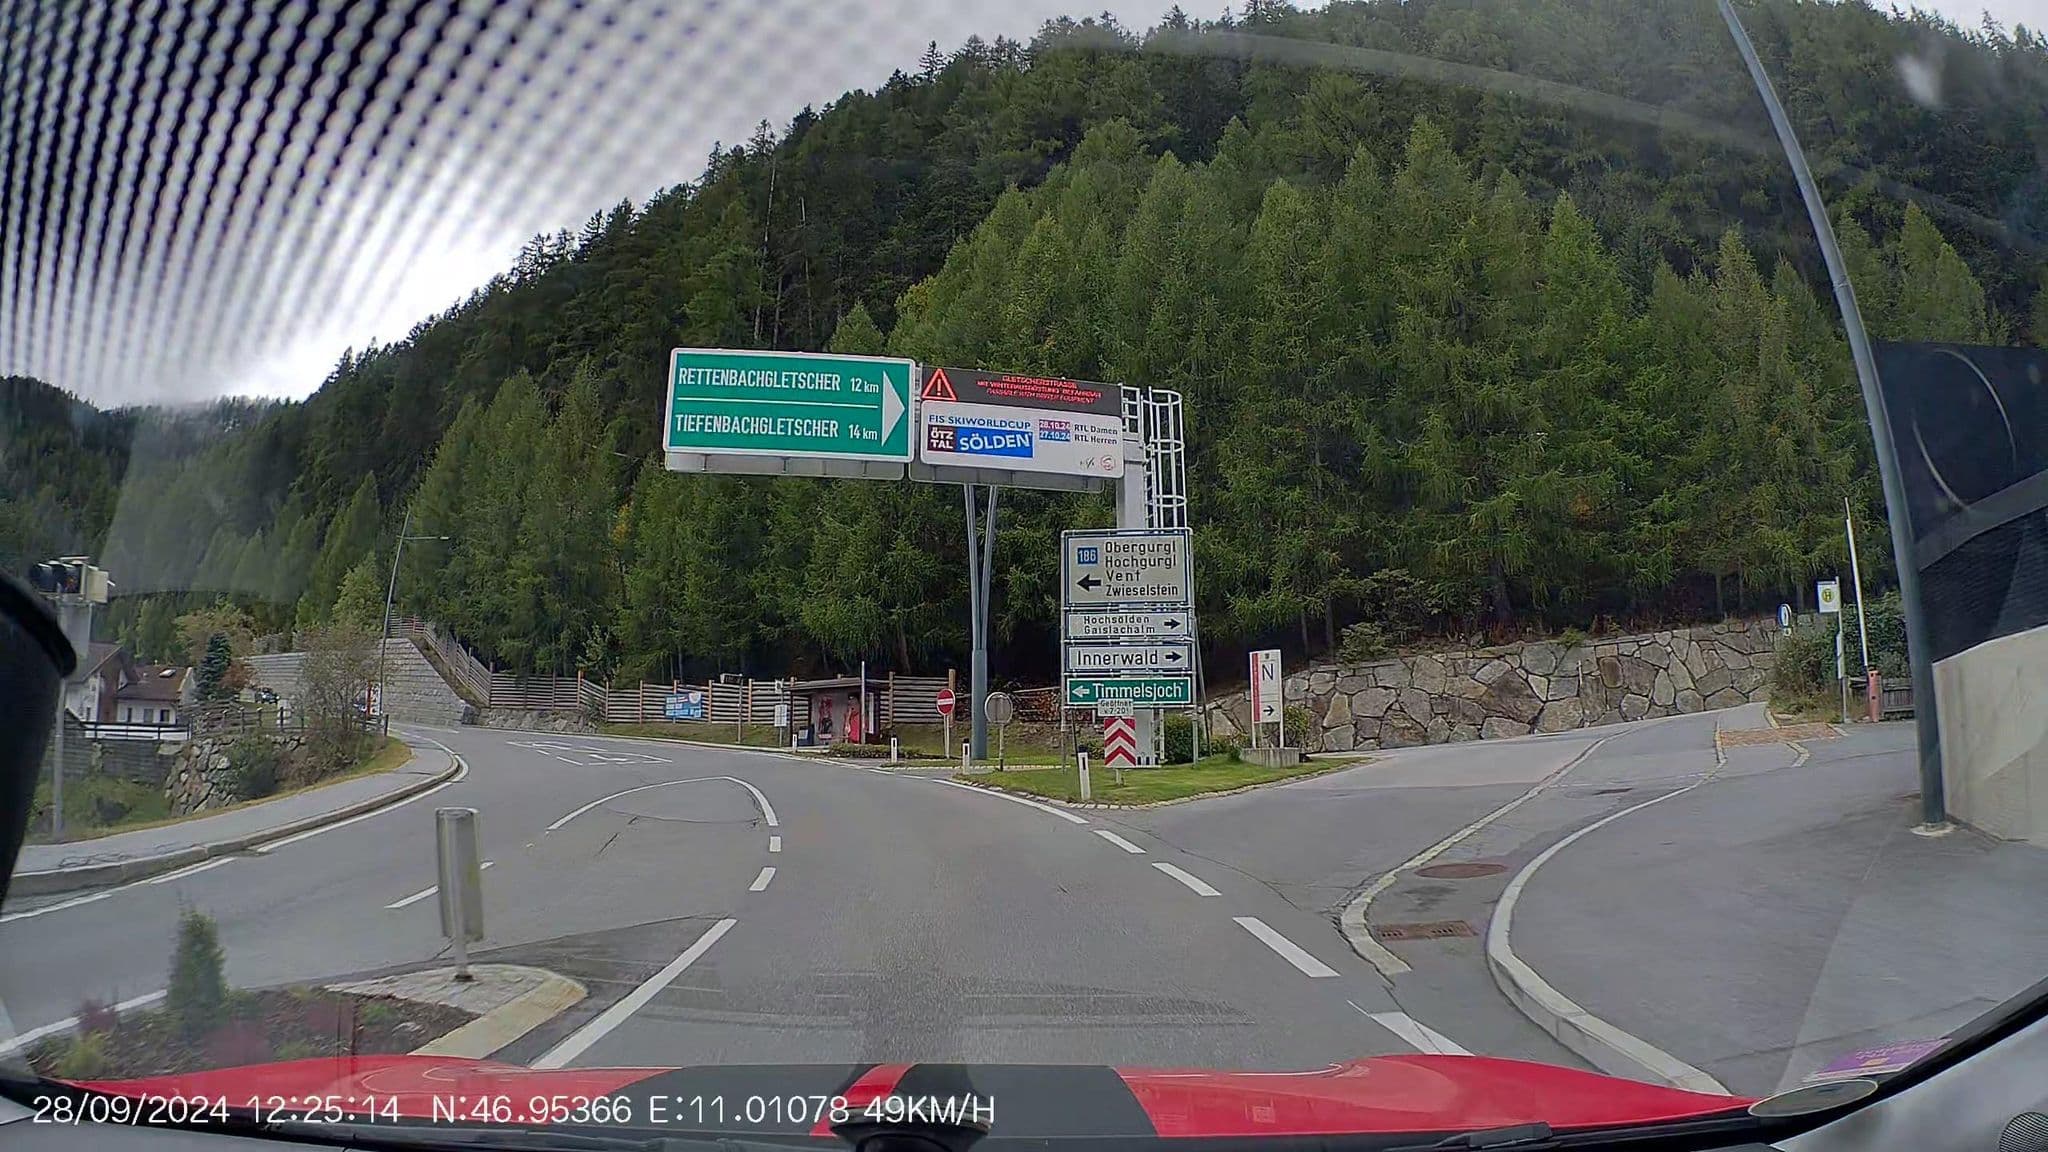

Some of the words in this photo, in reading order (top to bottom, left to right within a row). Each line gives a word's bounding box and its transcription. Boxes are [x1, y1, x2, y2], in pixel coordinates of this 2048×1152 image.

[678, 367, 841, 391] RETTENBACHGLETSCHER
[850, 377, 863, 393] 12
[863, 380, 880, 394] km
[675, 414, 839, 438] TIEFENBACHGLETSCHER
[848, 424, 861, 439] 14
[862, 428, 879, 441] km
[928, 414, 945, 424] FIS
[948, 416, 1031, 430] SKIWORLDCUP
[1074, 423, 1089, 433] RTL
[1090, 425, 1118, 435] Damen
[930, 426, 954, 440] ÖTZ
[1074, 433, 1089, 443] RTL
[1090, 434, 1118, 445] Herren
[930, 439, 954, 449] TAL
[960, 432, 1031, 451] SÖLDEN
[1105, 540, 1176, 556] Obergurgl
[1078, 549, 1097, 563] 186
[1105, 555, 1177, 570] Hochgurgl
[1106, 569, 1141, 582] Vent
[1106, 583, 1178, 597] Zwieselstein
[1084, 625, 1155, 635] Gaislachalm
[1077, 649, 1159, 666] Innerwald
[1262, 663, 1274, 681] N
[1092, 682, 1182, 701] Timmelsjoch
